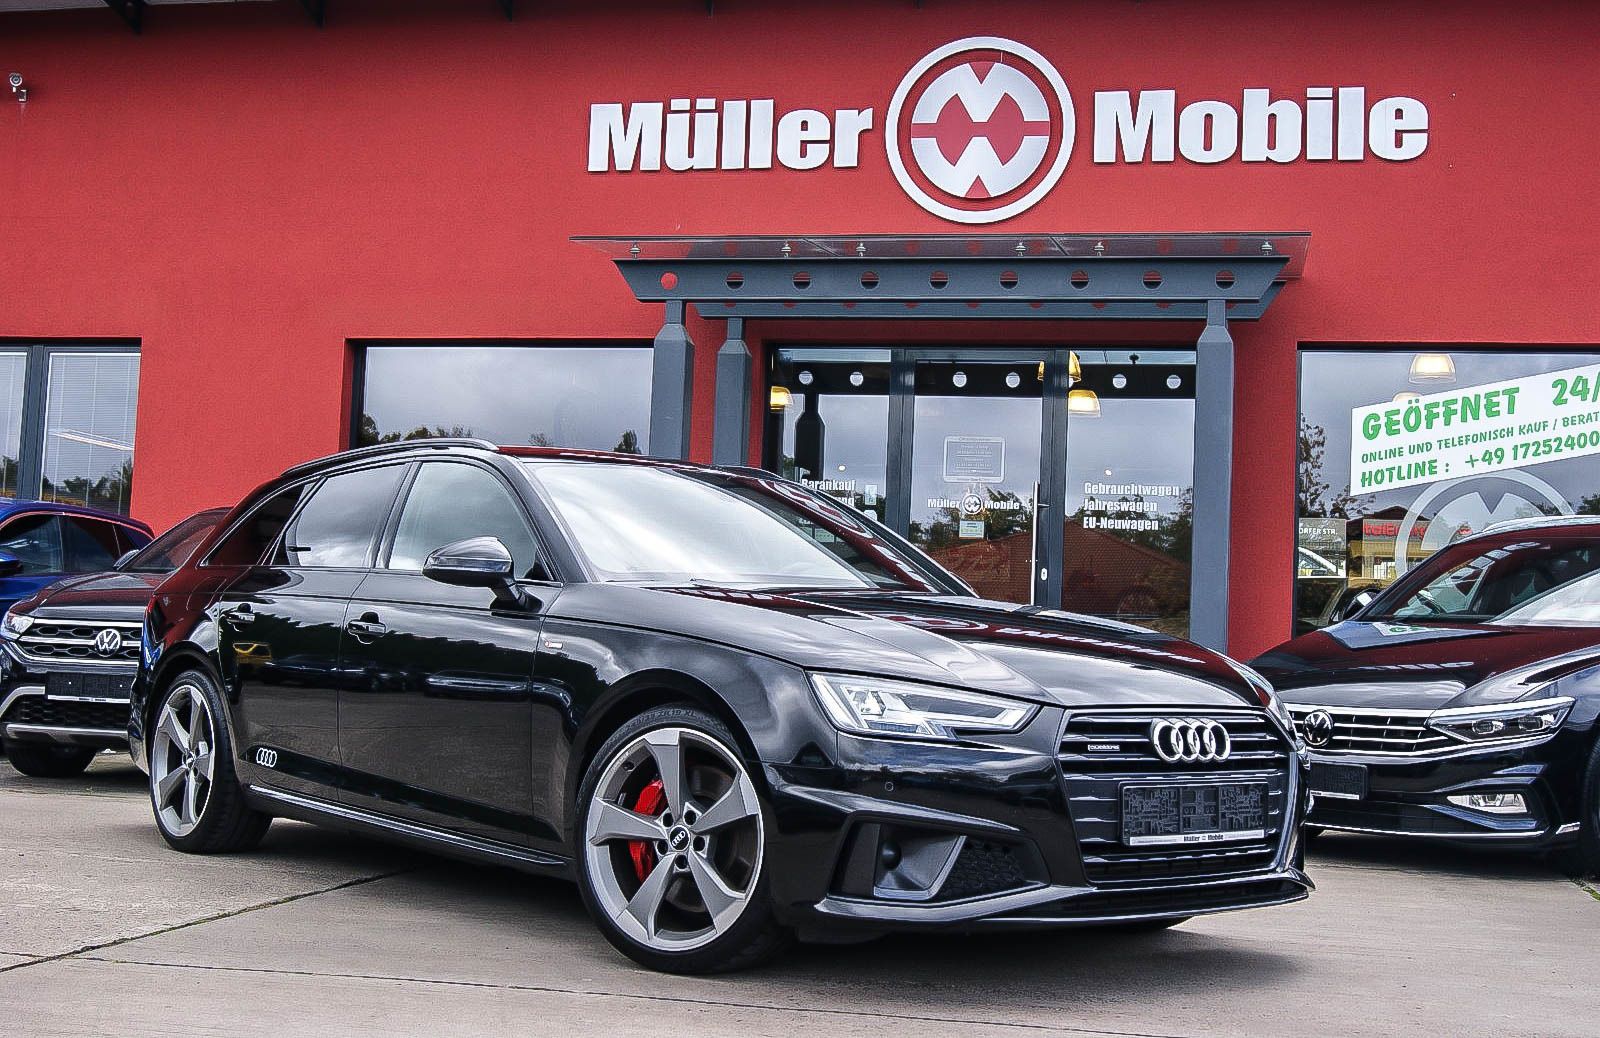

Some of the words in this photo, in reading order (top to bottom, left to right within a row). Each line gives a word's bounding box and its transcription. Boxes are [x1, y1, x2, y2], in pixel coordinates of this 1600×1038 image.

[588, 97, 874, 172] Müller
[1093, 86, 1429, 163] Mobile
[1362, 386, 1520, 441] GEÖFFNET
[1361, 446, 1404, 463] ONLINE
[1408, 441, 1433, 455] UND
[1436, 426, 1514, 451] TELEFONISCH
[1518, 420, 1549, 436] KAUF
[1360, 458, 1438, 488] HOTLINE
[1465, 447, 1505, 468] +49
[1512, 430, 1600, 461] 17252400
[927, 498, 961, 508] Müller
[984, 500, 1020, 510] Mobile
[1084, 482, 1180, 497] Gebrauchtwagen
[1083, 498, 1158, 513] Jahreswagen
[1083, 516, 1159, 532] EU-Neuwagen
